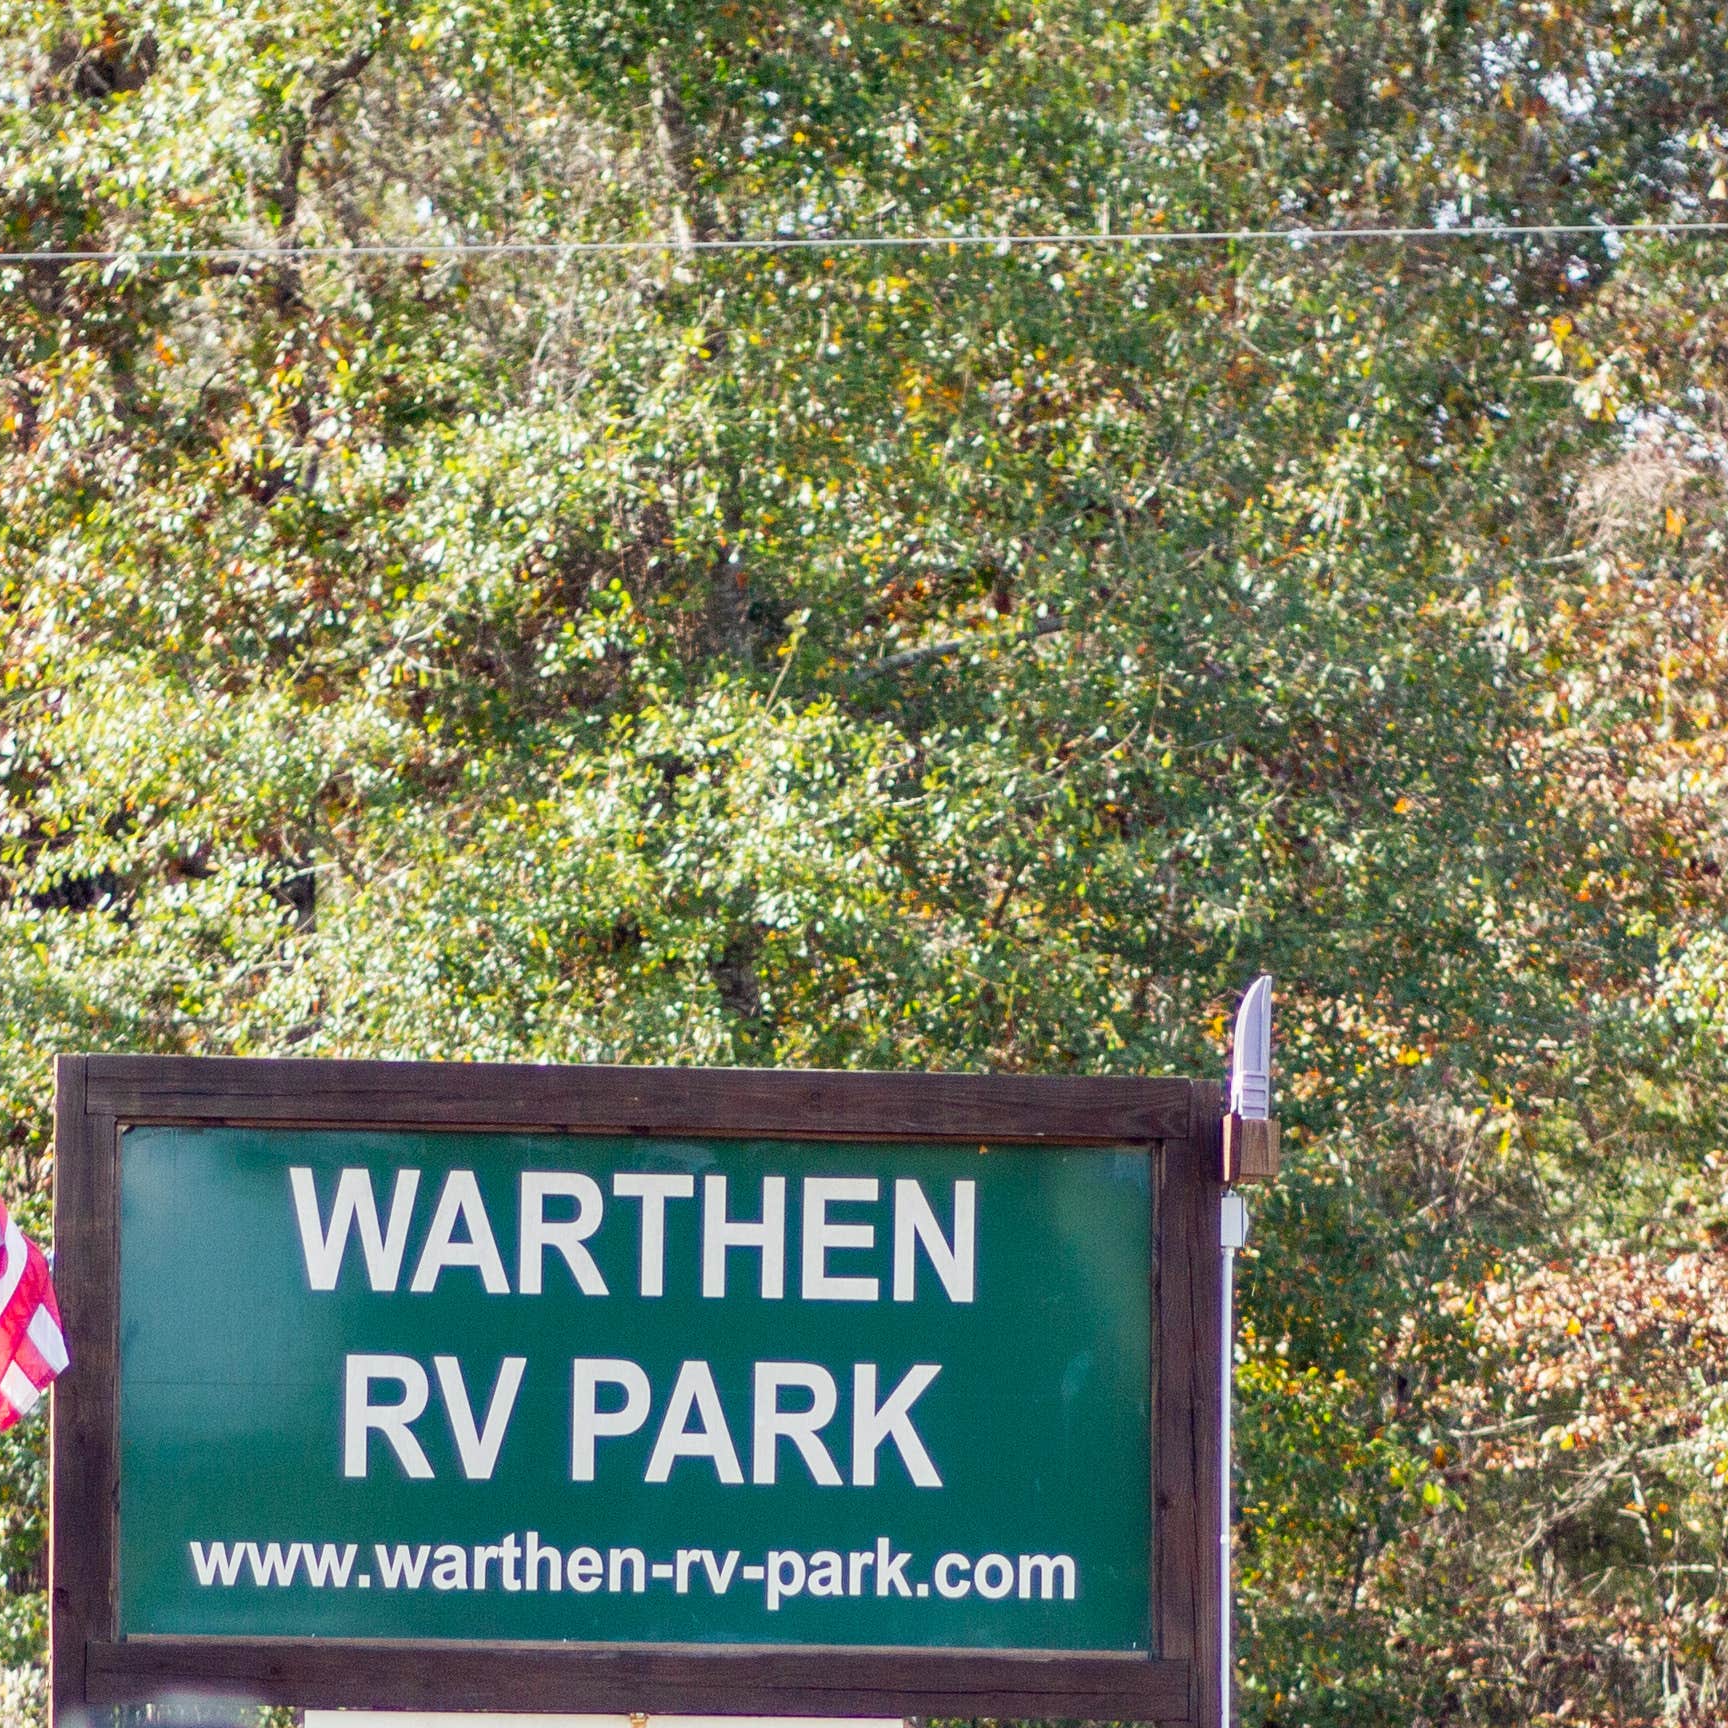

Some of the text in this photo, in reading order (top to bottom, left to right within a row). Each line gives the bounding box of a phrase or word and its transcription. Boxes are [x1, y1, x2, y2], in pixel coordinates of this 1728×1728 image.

[289, 1165, 976, 1303] WARTHEN
[344, 1354, 943, 1488] RV PARK
[189, 1530, 1076, 1611] www.warthen-rv-park.com
